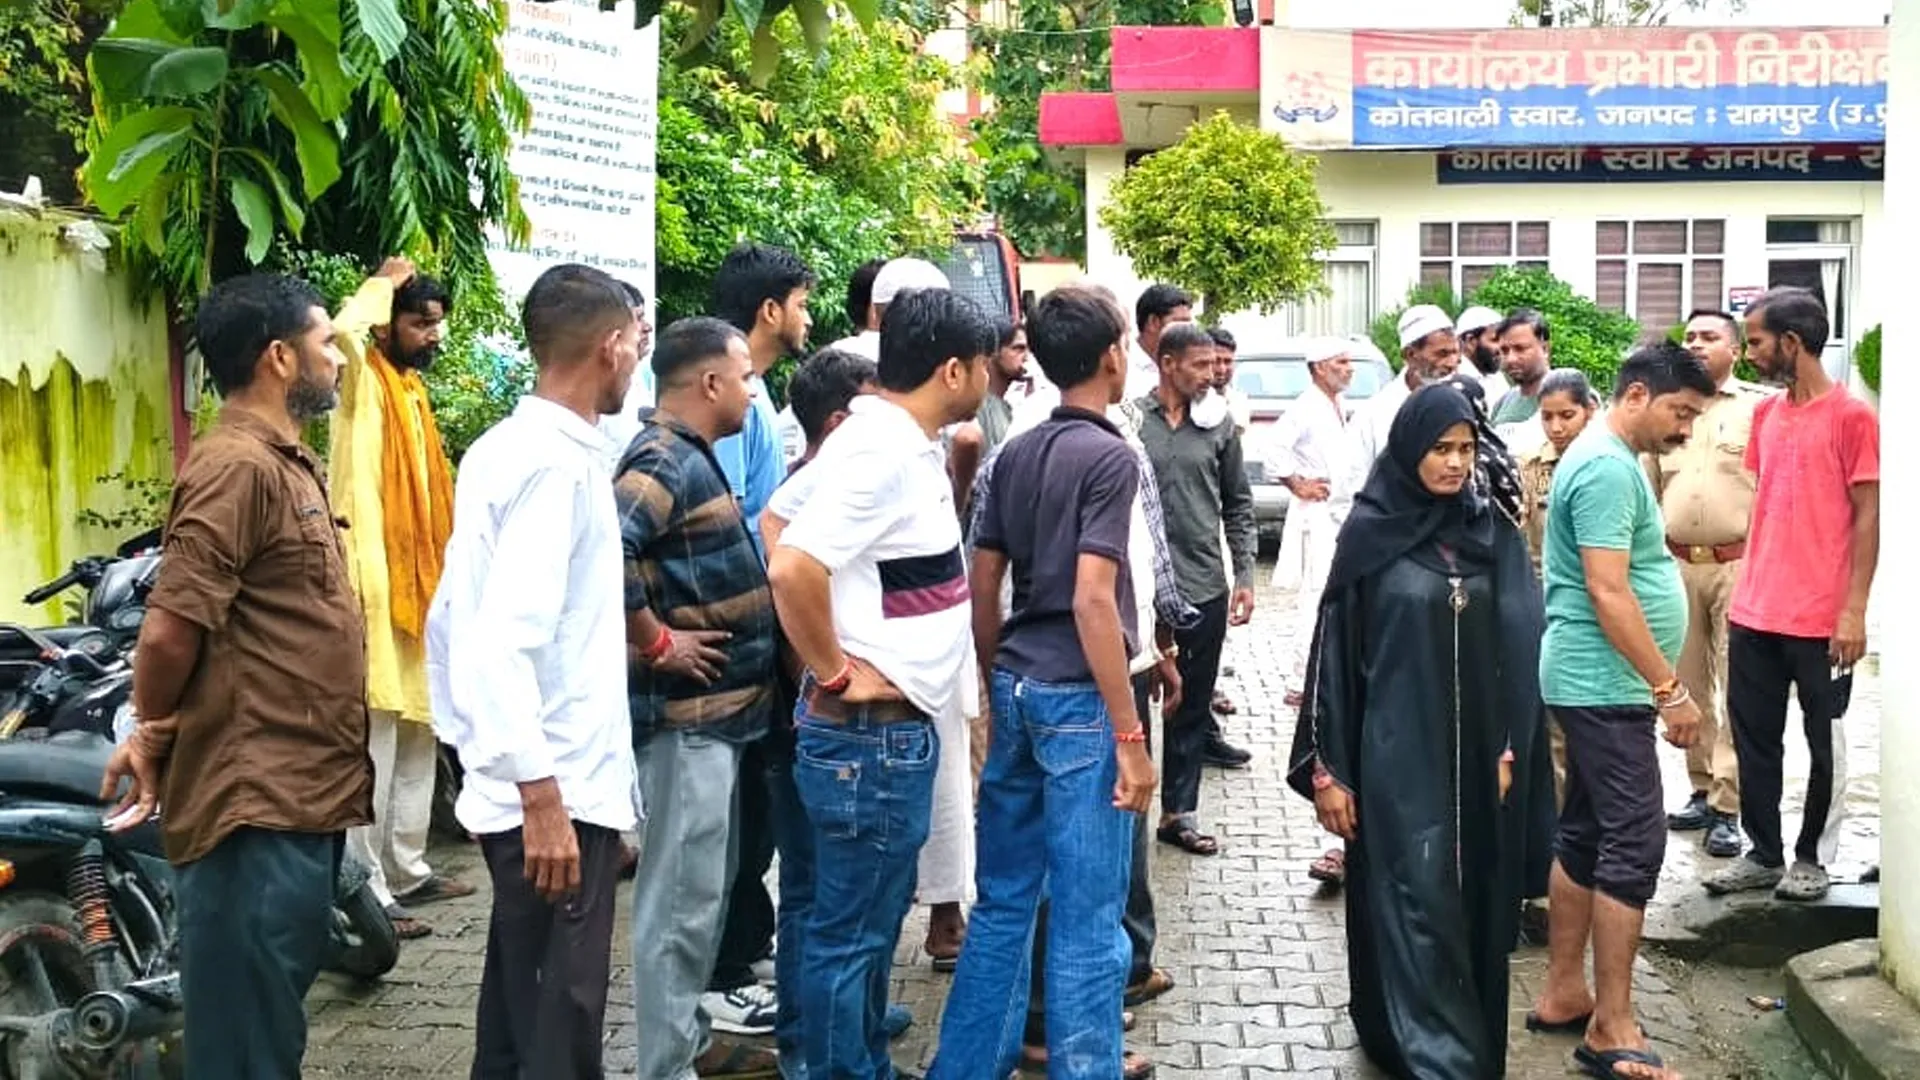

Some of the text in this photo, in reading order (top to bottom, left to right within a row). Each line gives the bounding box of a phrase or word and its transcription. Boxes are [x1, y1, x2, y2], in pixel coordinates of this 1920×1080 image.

[1363, 32, 1569, 91] कार्यालय
[1582, 32, 1720, 96] प्रभारी
[1368, 98, 1500, 127] कोतवाली
[1595, 104, 1697, 126] जनपद
[1726, 104, 1821, 135] रामपुर
[1602, 147, 1690, 171] स्वार
[1702, 146, 1815, 174] जनपद
